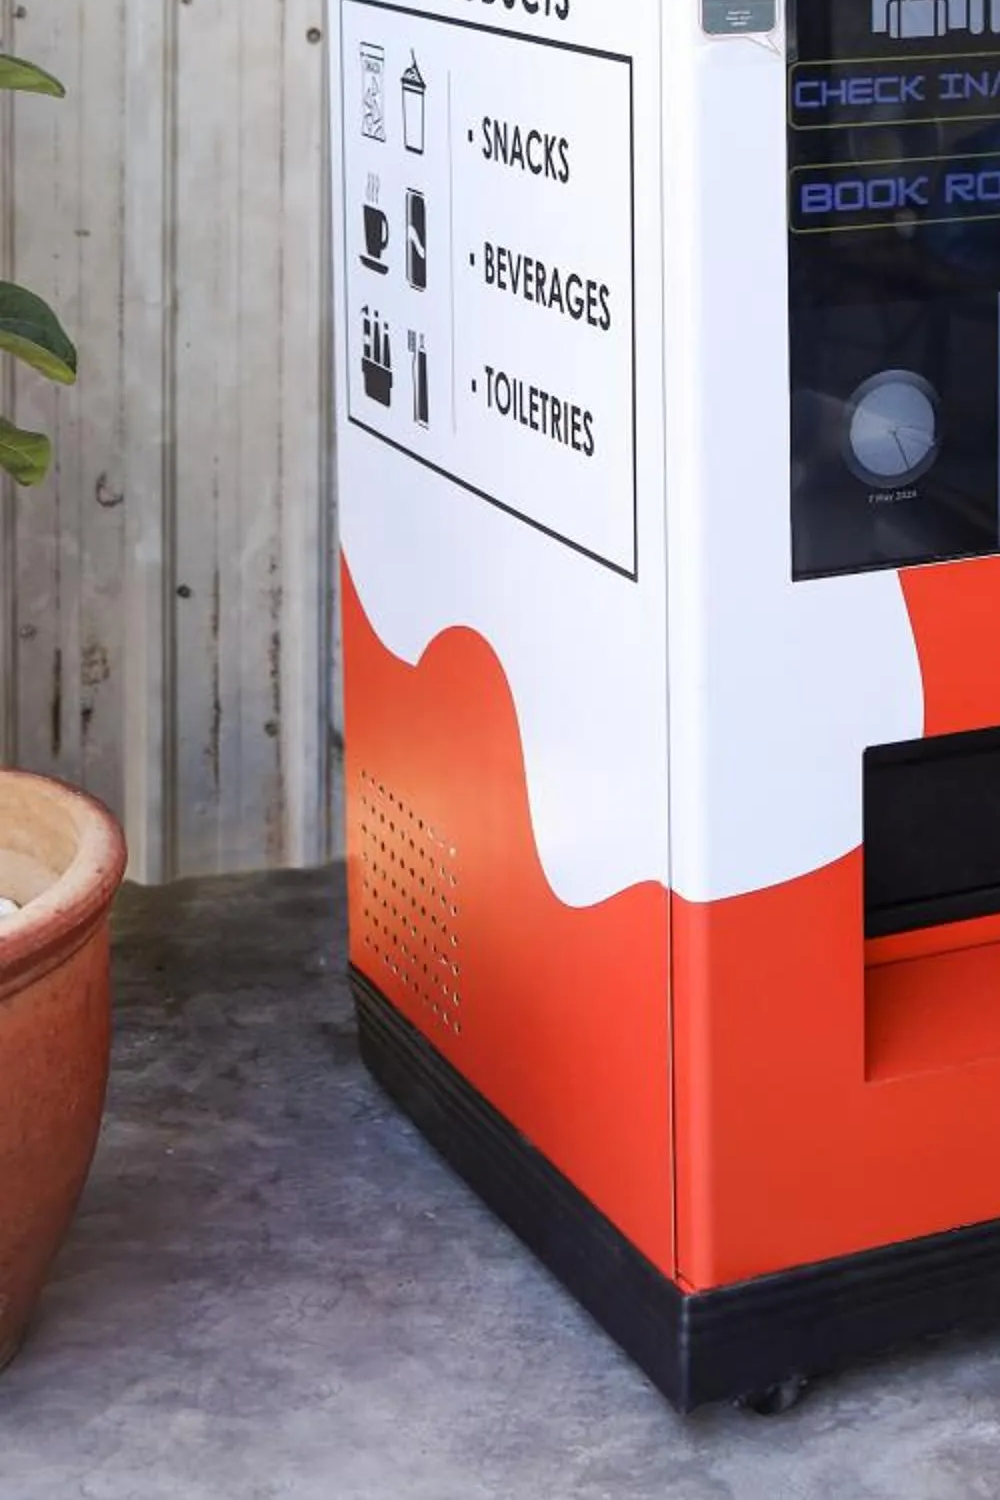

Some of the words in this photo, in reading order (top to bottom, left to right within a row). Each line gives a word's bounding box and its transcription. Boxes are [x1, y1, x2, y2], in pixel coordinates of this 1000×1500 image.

[794, 76, 926, 108] CHECK
[482, 116, 570, 184] SNACKS
[801, 177, 928, 214] BOOK
[484, 241, 611, 331] BEVERAGES
[485, 365, 595, 457] TOILETRIES
